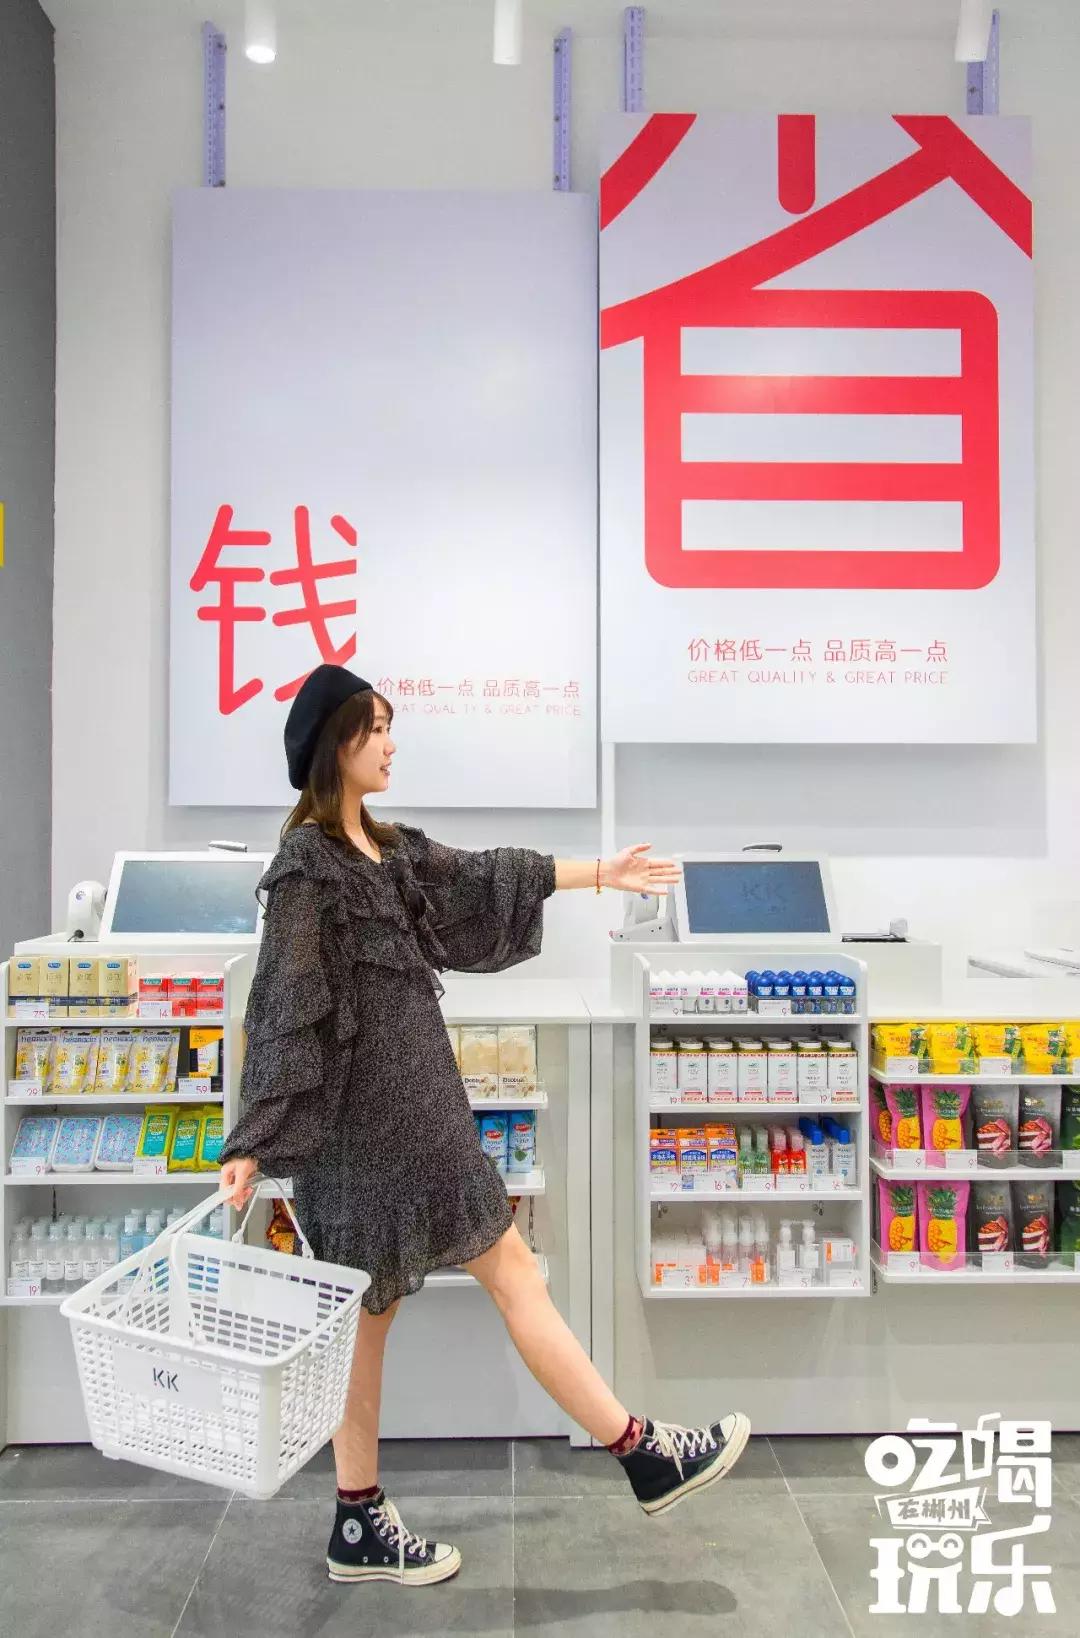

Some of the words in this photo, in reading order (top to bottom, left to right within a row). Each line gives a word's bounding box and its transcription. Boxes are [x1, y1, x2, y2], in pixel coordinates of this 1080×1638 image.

[600, 113, 1034, 591] 省
[189, 504, 357, 716] 钱
[687, 638, 813, 663] 价格低一点
[823, 638, 949, 663] 品质高一点
[376, 677, 475, 698] 价格低一点
[482, 679, 580, 699] 品质高一点
[687, 670, 738, 684] GREAT
[747, 670, 817, 685] QUALITY
[825, 671, 836, 684] &
[844, 670, 895, 684] GREAT
[904, 670, 949, 685] PRICE
[393, 703, 416, 714] EAT
[484, 703, 493, 714] &
[545, 704, 581, 717] PRICE
